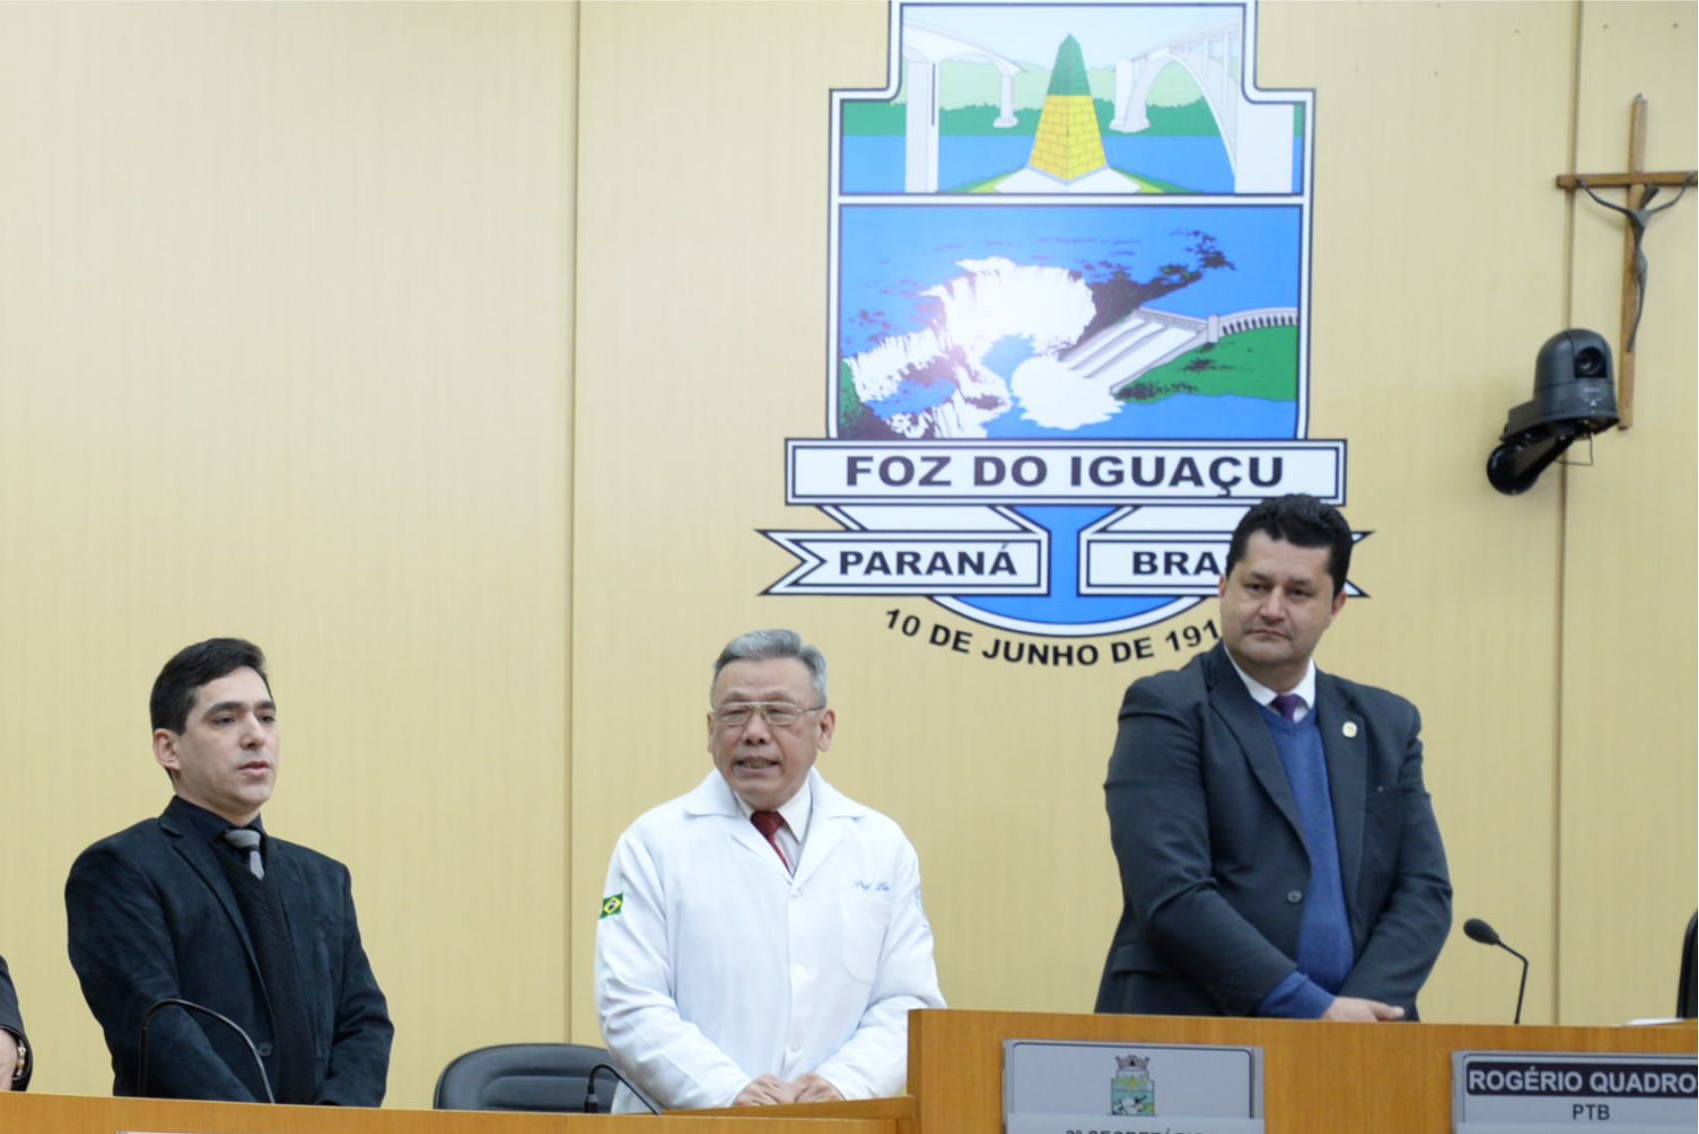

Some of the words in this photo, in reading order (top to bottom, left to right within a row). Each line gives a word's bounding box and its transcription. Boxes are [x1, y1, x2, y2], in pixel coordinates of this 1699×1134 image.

[845, 455, 952, 487] FOZ
[973, 455, 1048, 487] DO
[1070, 455, 1284, 499] IGUAÇU
[839, 543, 1018, 576] PARANÁ
[1132, 550, 1221, 576] BRA
[885, 608, 921, 637] 10
[929, 623, 974, 653] DE
[982, 638, 1100, 666] JUNHO
[1110, 636, 1155, 664] DE
[1164, 618, 1220, 652] 191
[1468, 1065, 1583, 1092] ROGÉRIO
[1589, 1071, 1698, 1094] QUADRO
[1572, 1103, 1610, 1121] PTB
